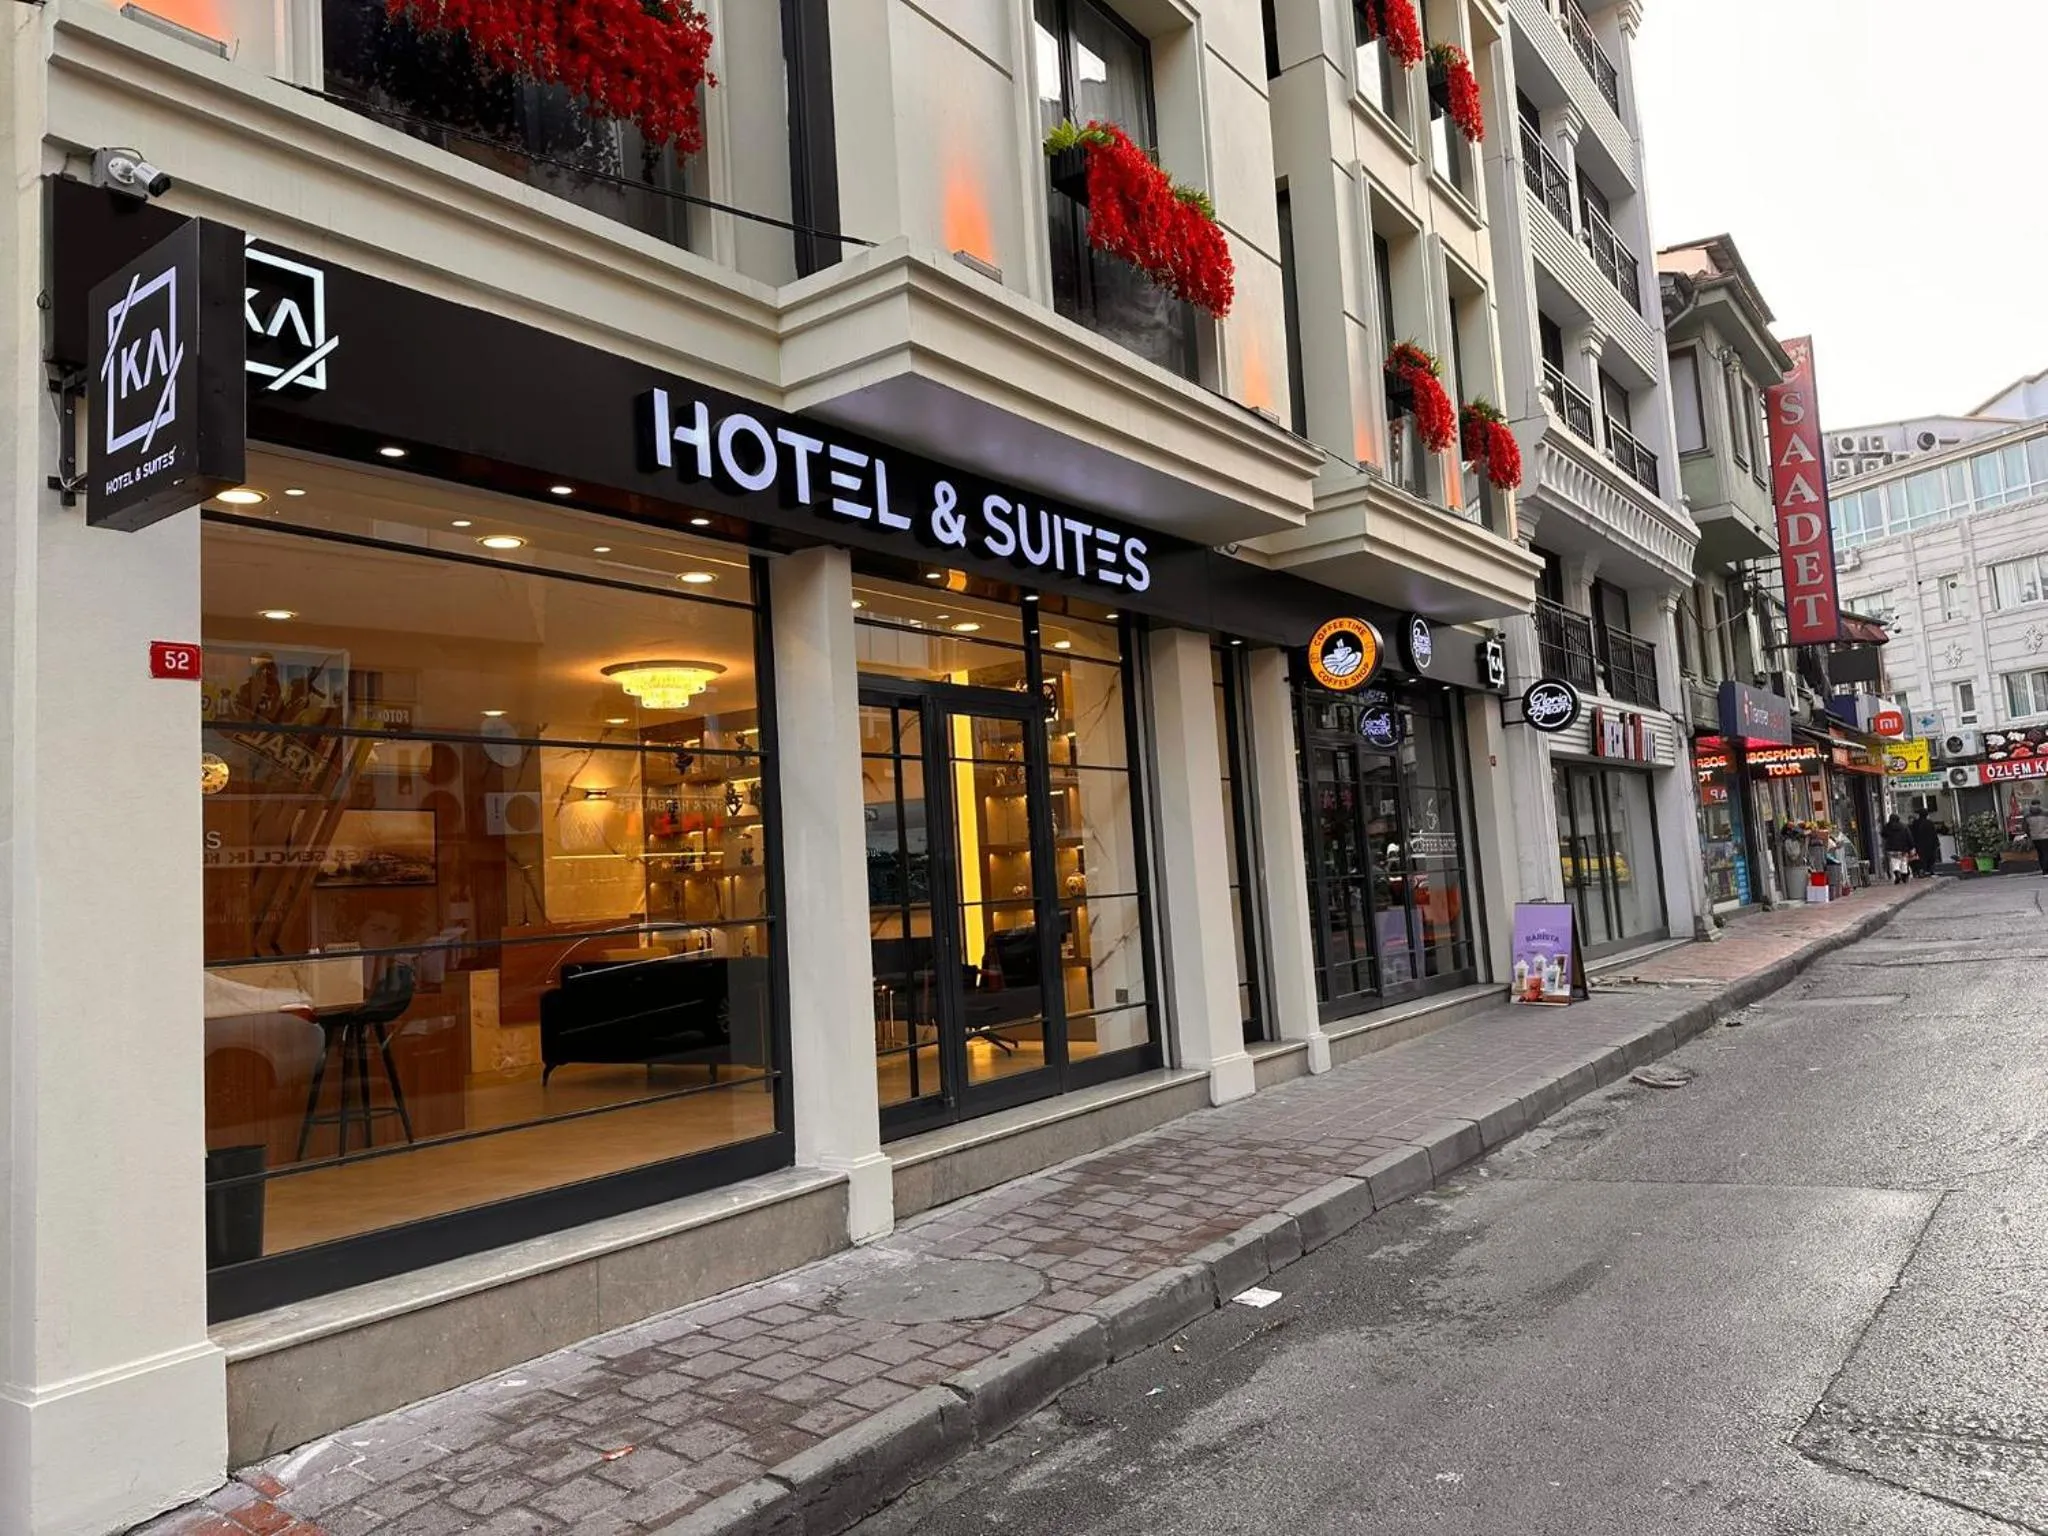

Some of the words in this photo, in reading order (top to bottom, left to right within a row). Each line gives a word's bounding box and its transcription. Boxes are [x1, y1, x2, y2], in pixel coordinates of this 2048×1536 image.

[121, 328, 168, 399] KA
[106, 471, 134, 496] HOTEL
[135, 466, 141, 482] &
[143, 450, 175, 477] SUITES
[653, 387, 911, 530] HOTEL
[931, 480, 967, 548] &
[983, 494, 1150, 592] SUITES
[1779, 391, 1828, 628] SAADET
[1314, 620, 1344, 647] COFFEE
[1348, 620, 1366, 636] TIME
[165, 650, 189, 670] 52
[1318, 671, 1350, 687] COFFEE
[1351, 662, 1369, 683] SHOP
[1765, 762, 1802, 776] TOUR
[1986, 761, 2032, 779] ÖZLEM
